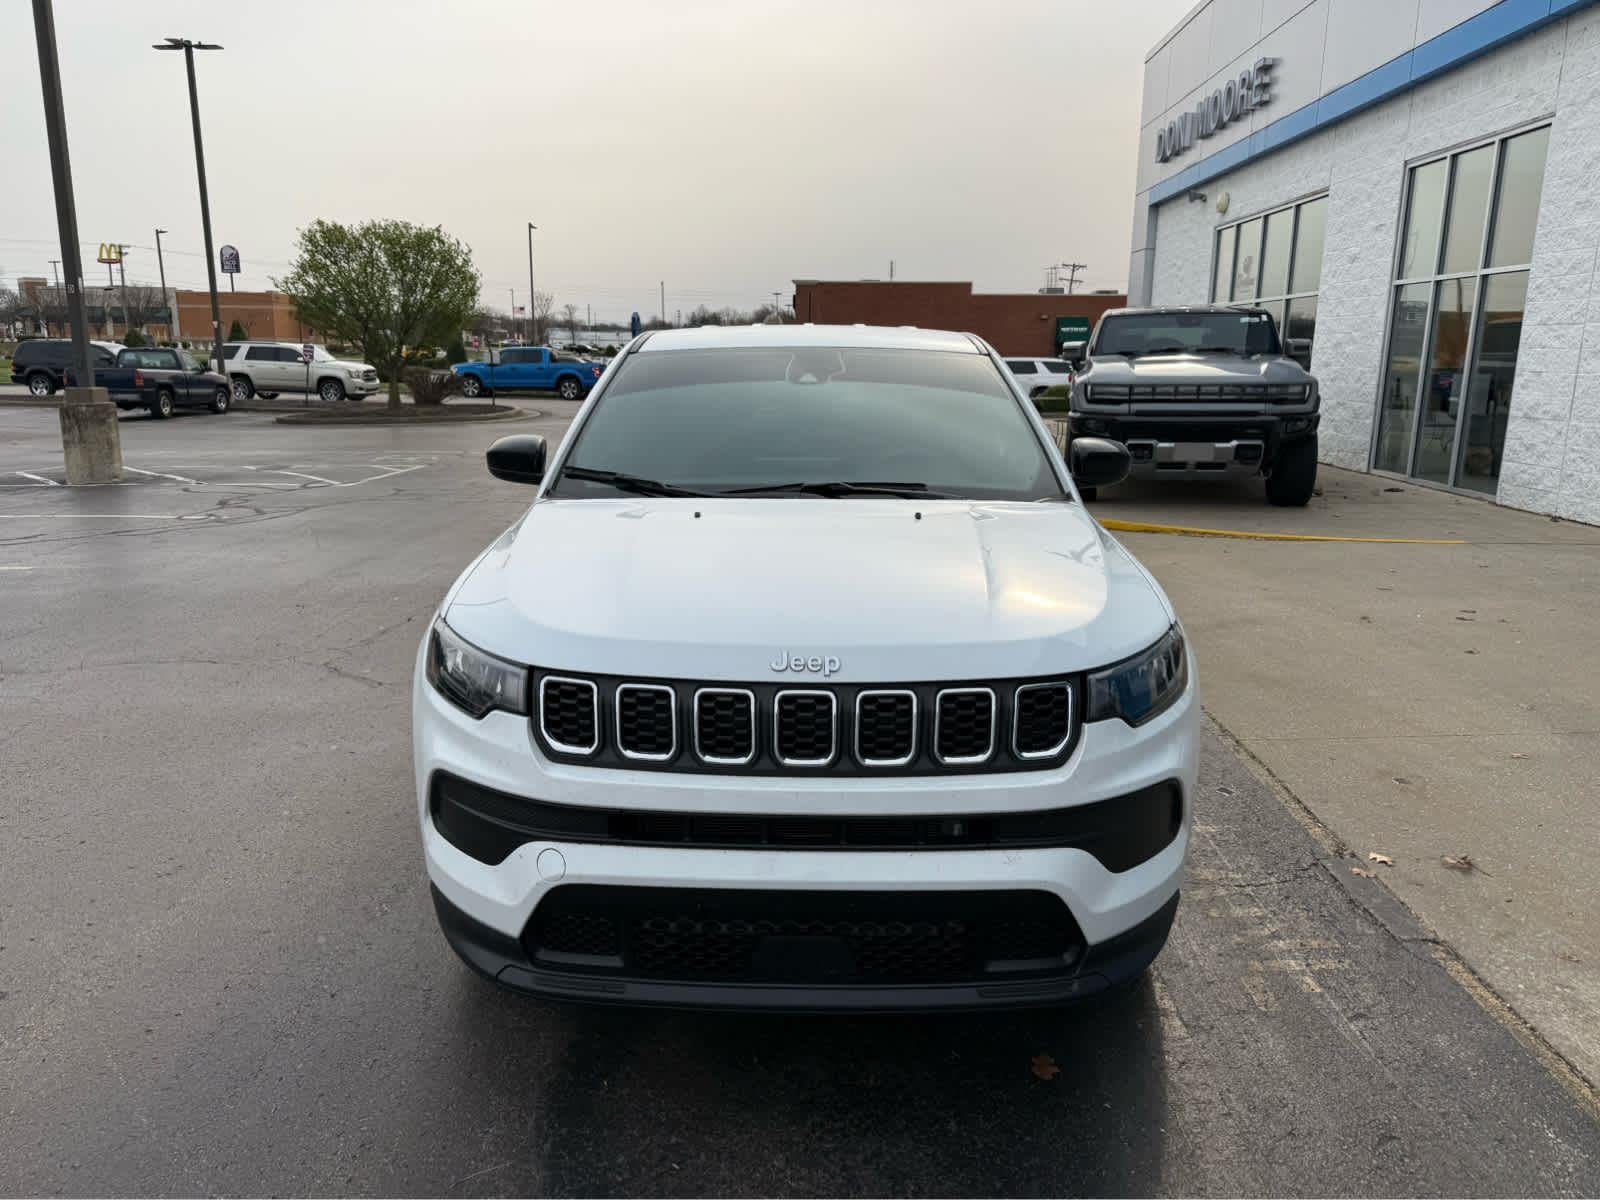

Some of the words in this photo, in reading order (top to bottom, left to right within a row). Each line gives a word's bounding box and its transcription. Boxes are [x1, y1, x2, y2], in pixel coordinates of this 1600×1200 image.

[1155, 112, 1196, 163] DON
[1197, 57, 1275, 140] MOORE
[770, 649, 841, 677] Jeep
